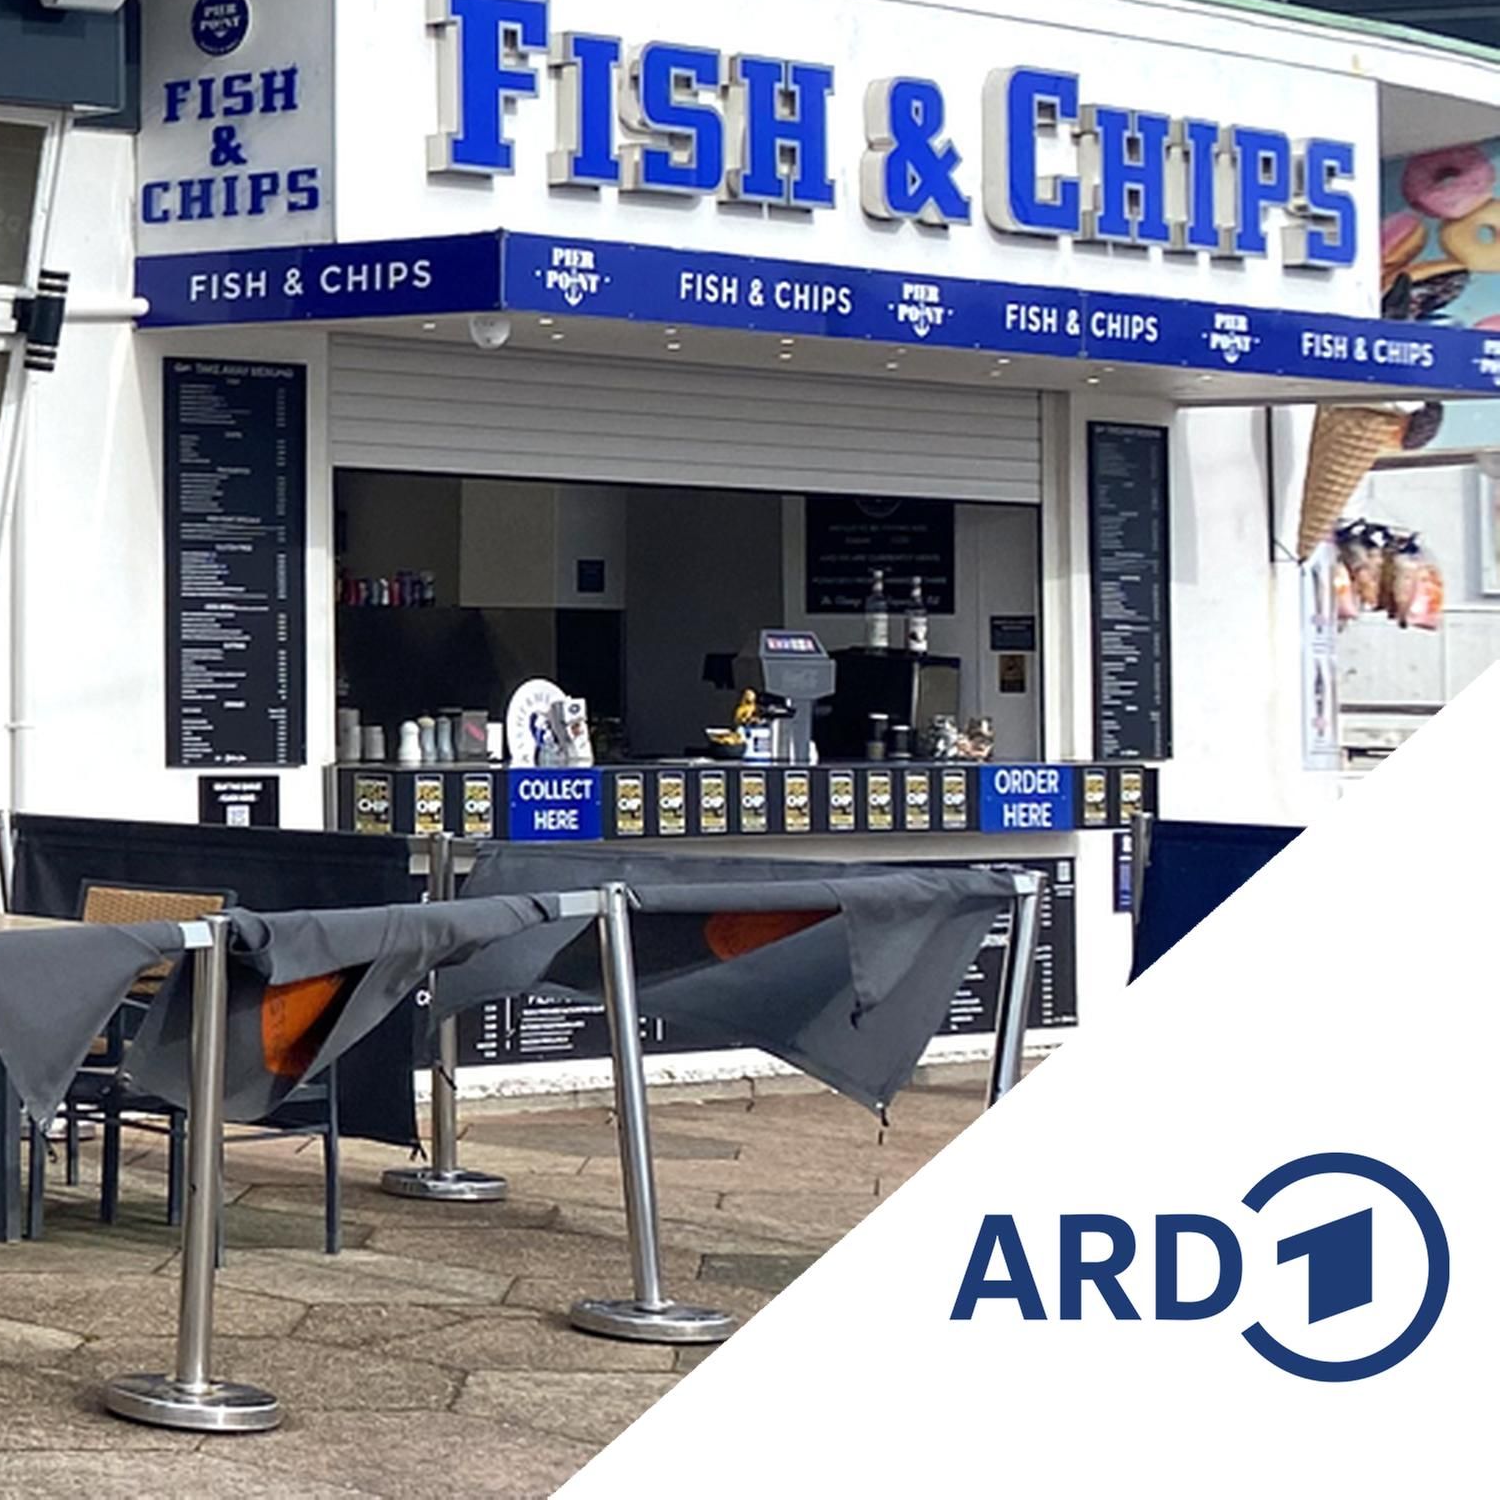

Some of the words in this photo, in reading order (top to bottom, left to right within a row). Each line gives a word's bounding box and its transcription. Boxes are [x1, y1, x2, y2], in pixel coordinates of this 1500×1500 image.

[163, 65, 299, 124] FISH
[210, 125, 248, 167] &
[883, 77, 970, 224] &
[1006, 66, 1357, 268] CHIPS
[142, 168, 319, 224] CHIPS
[551, 247, 595, 270] PIER
[190, 270, 267, 301] FISH
[283, 267, 304, 296] &
[320, 260, 432, 293] CHIPS
[680, 272, 739, 305] FISH
[748, 278, 765, 307] &
[774, 281, 852, 315] CHIPS
[902, 282, 940, 303] PIER
[1005, 303, 1059, 333] FISH
[1065, 309, 1080, 336] &
[1090, 311, 1159, 342] CHIPS
[1301, 331, 1348, 359] FISH
[1353, 336, 1368, 362] &
[1372, 338, 1434, 367] CHIPS
[519, 779, 593, 801] COLLECT
[995, 769, 1060, 794] ORDER
[534, 809, 579, 830] HERE
[1003, 802, 1052, 828] HERE
